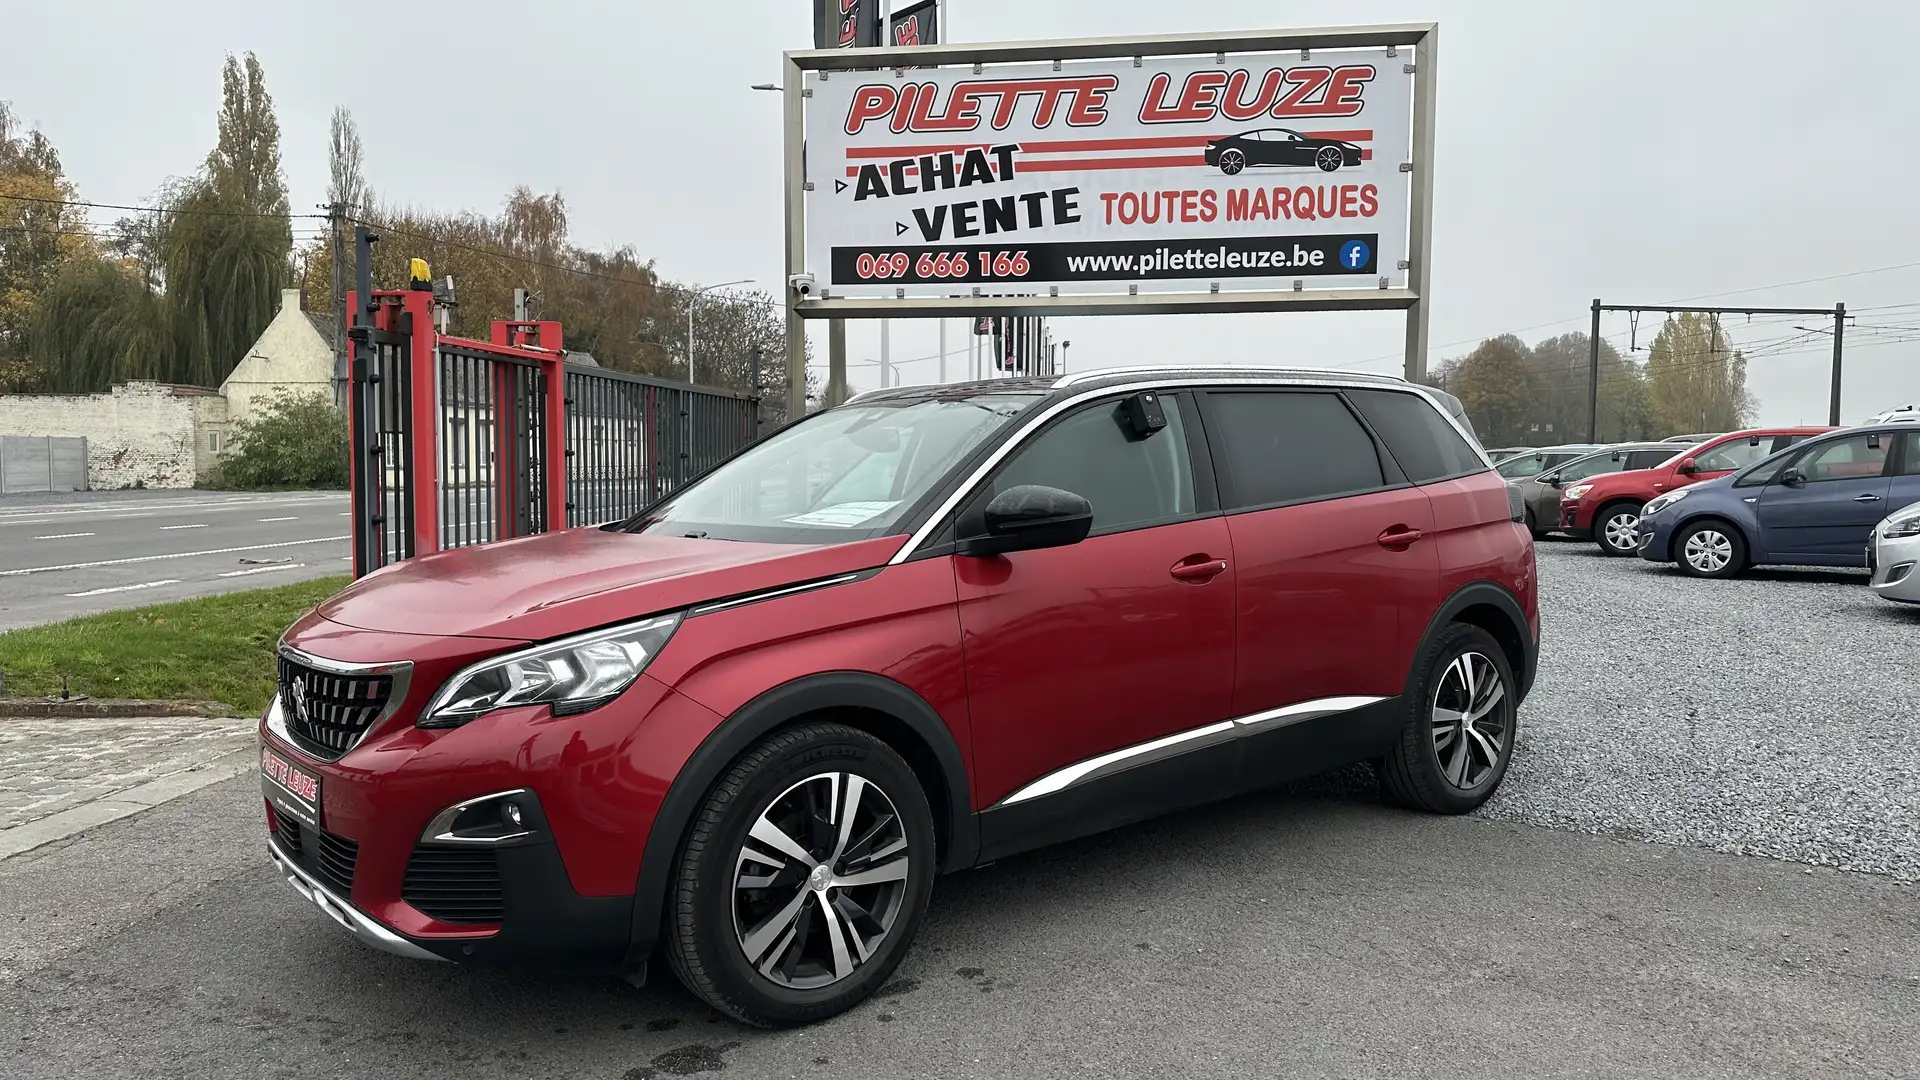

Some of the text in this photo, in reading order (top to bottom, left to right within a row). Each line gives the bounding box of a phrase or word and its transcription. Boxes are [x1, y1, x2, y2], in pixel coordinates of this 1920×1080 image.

[844, 62, 1376, 135] PILETTE LEUZE
[854, 144, 1021, 202] ACHAT
[912, 186, 1082, 243] VENTE
[1101, 184, 1379, 225] TOUTES MARQUES
[855, 250, 1031, 280] 069 666 166
[1066, 243, 1325, 276] www.piletteleuze.be
[262, 747, 318, 802] PILETTE LEUZE
